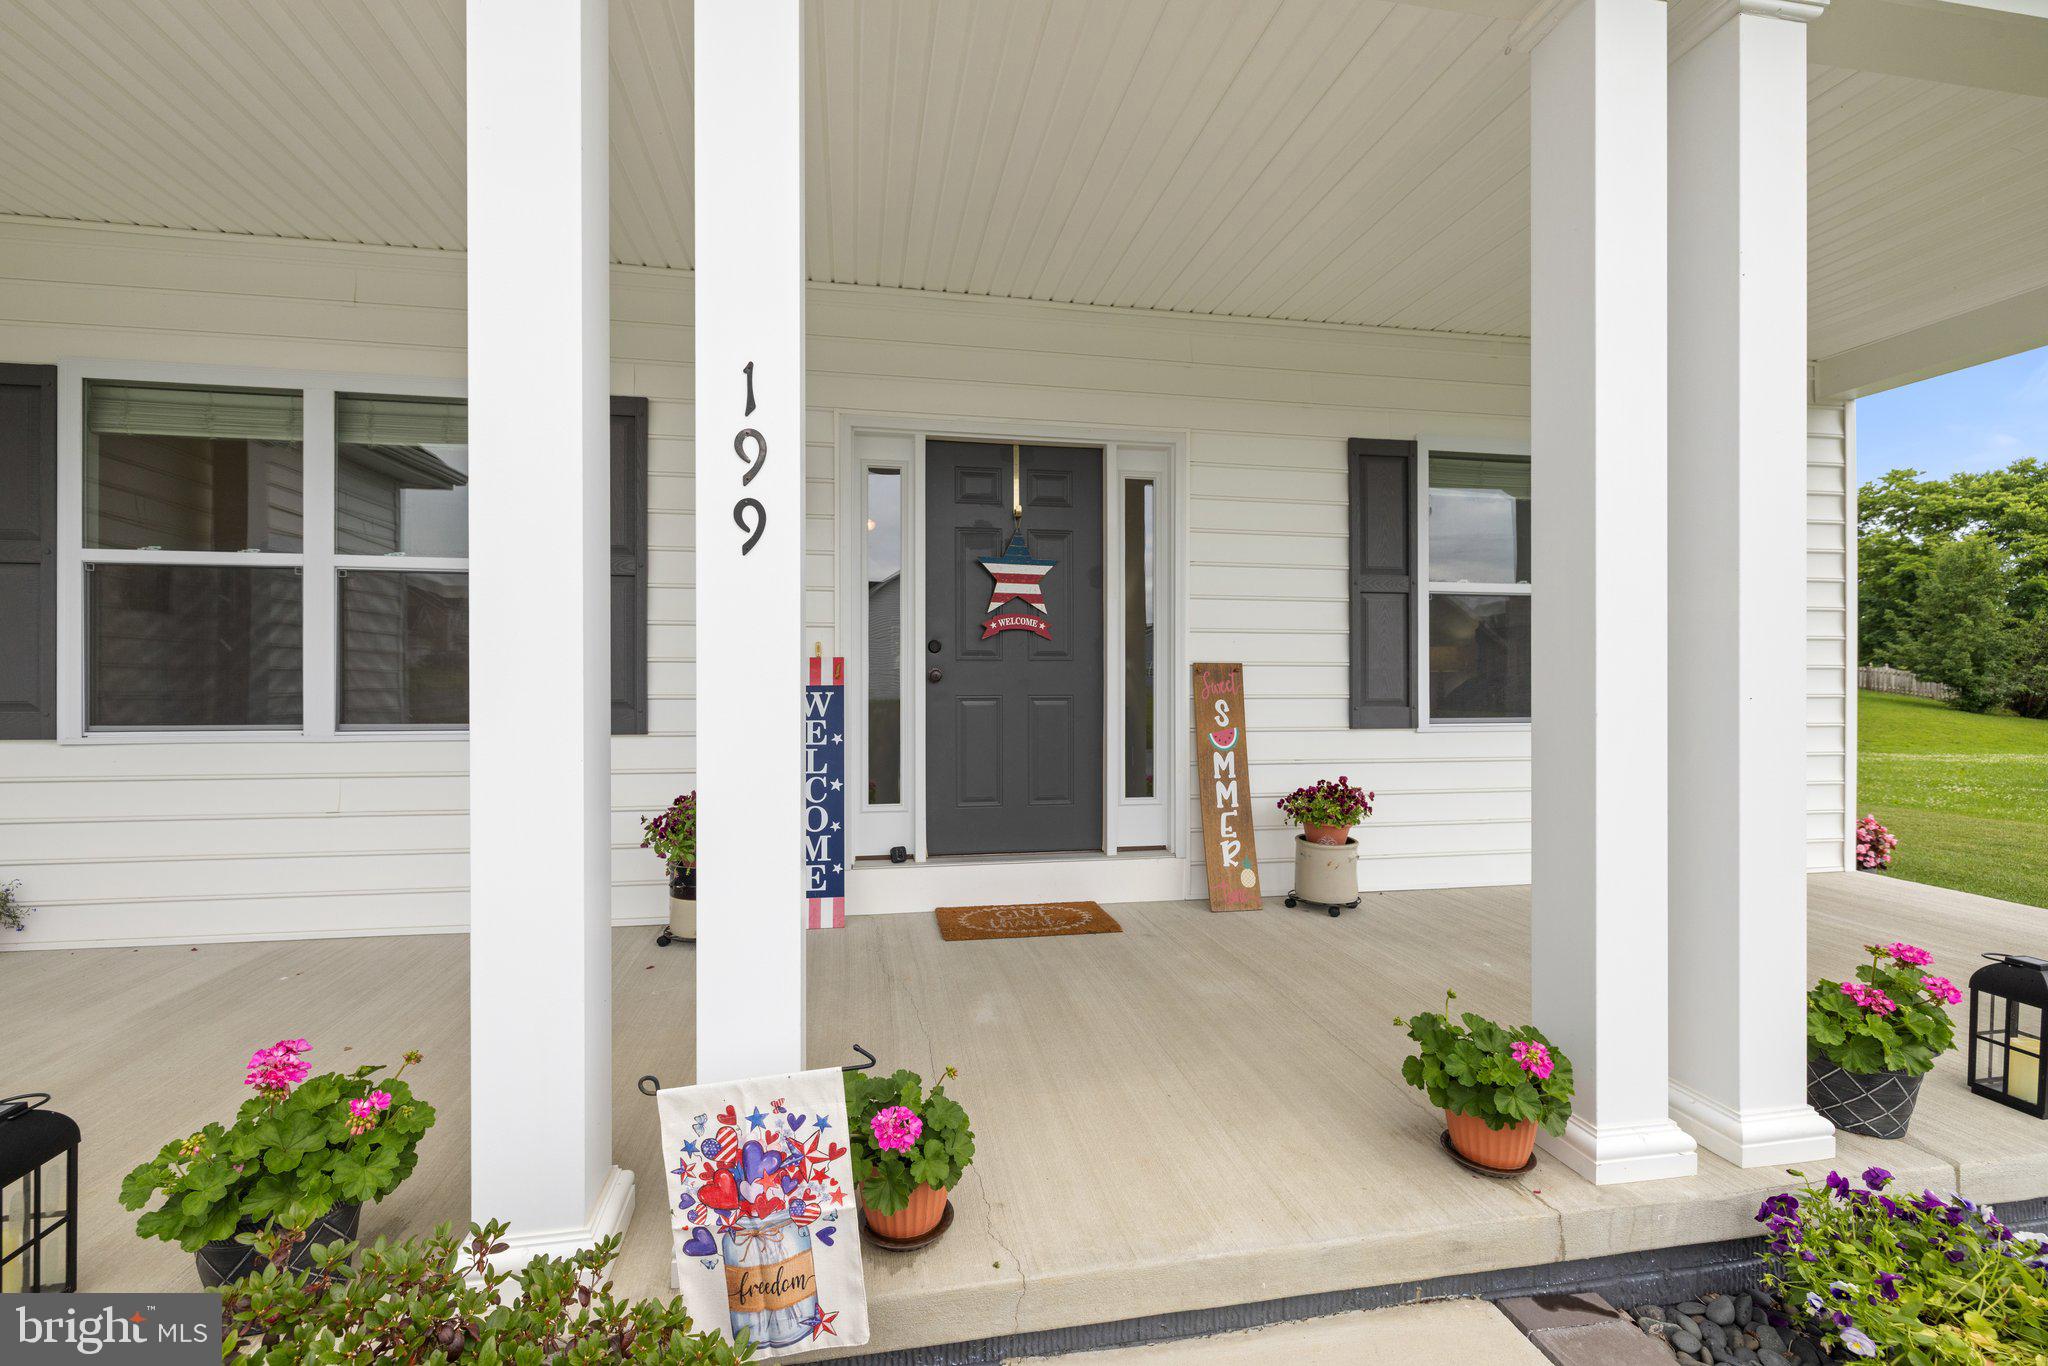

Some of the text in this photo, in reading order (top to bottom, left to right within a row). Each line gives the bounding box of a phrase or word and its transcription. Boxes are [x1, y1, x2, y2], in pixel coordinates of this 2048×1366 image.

[733, 361, 767, 556] 199
[998, 617, 1038, 628] WELCOME
[805, 691, 834, 891] WELCOME
[728, 1266, 815, 1305] freedom
